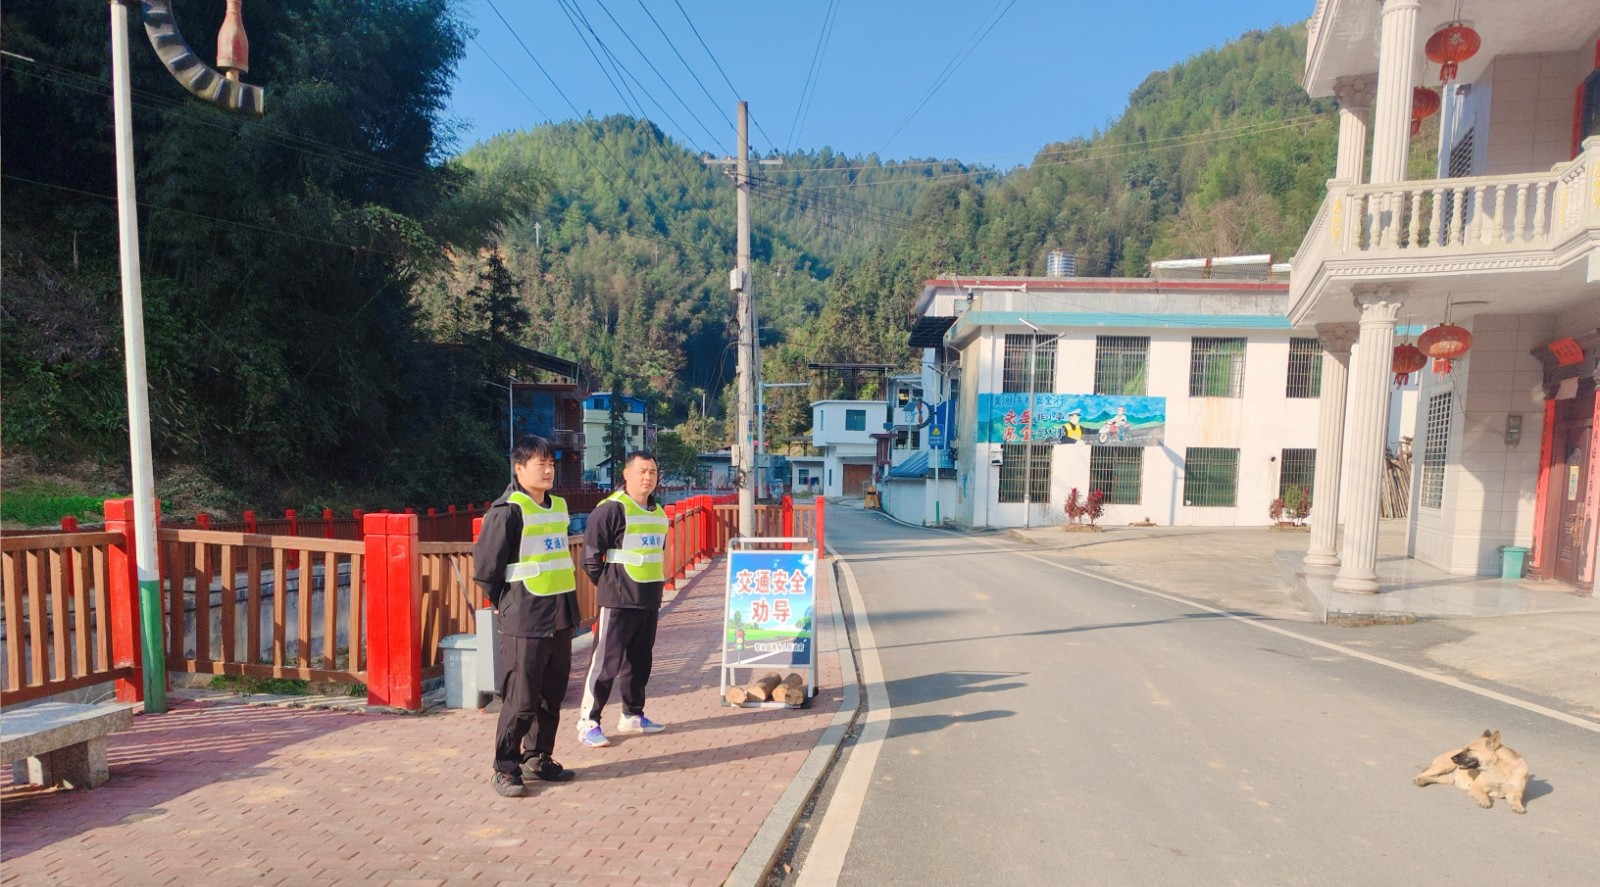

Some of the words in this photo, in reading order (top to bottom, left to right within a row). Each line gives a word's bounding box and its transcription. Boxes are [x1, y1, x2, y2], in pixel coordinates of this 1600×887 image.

[737, 570, 806, 594] 交通安全
[751, 598, 791, 623] 劝导
